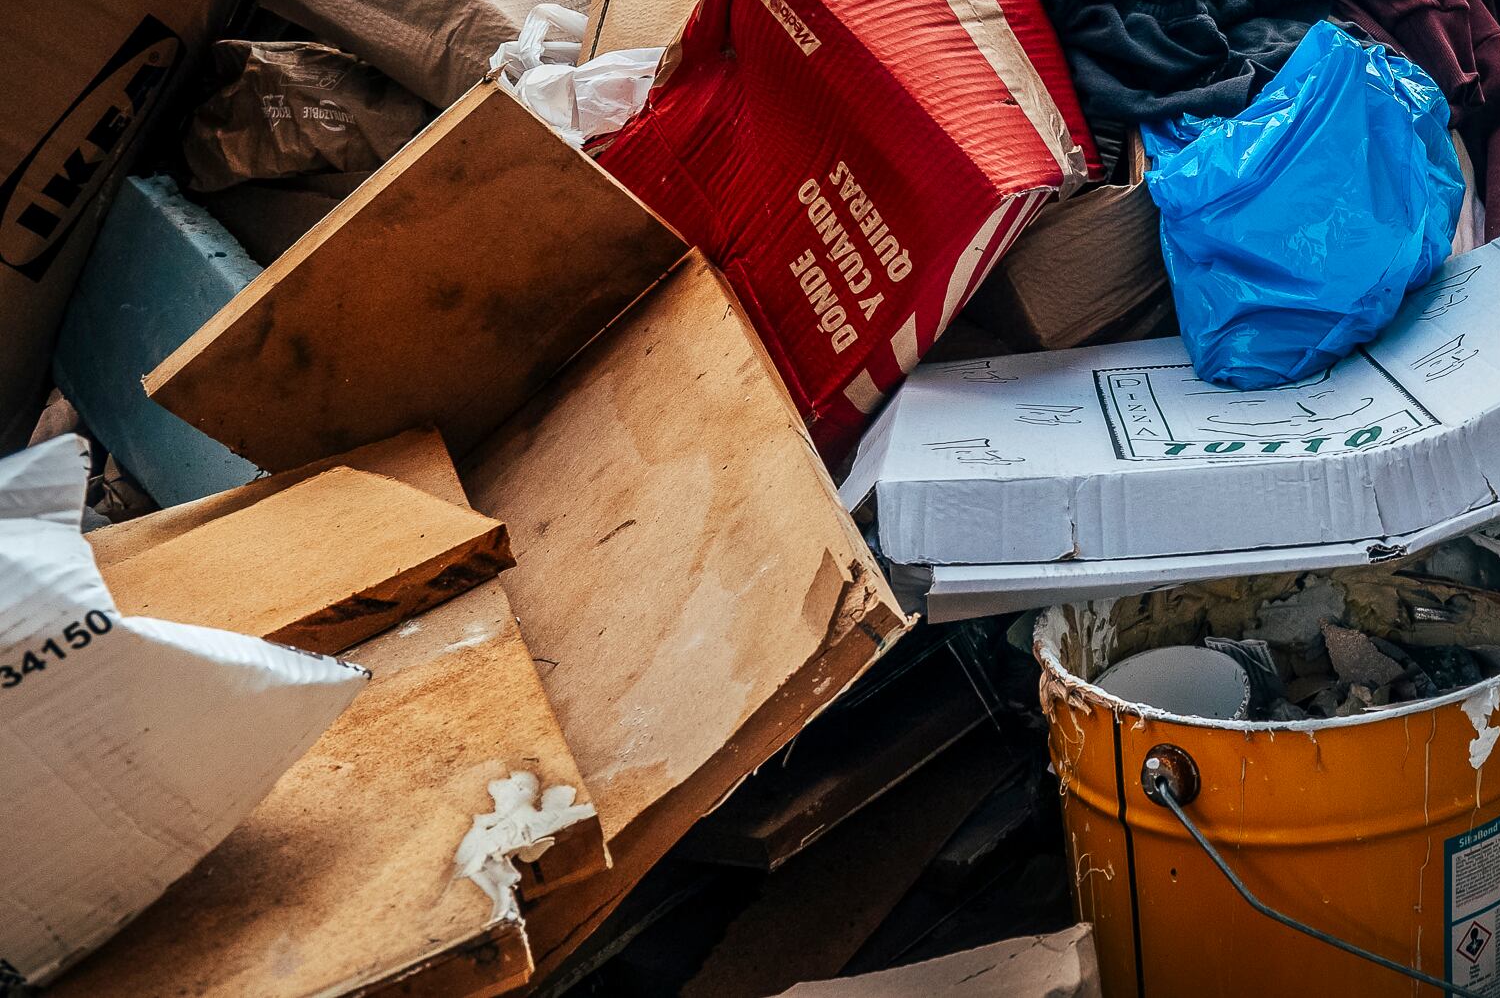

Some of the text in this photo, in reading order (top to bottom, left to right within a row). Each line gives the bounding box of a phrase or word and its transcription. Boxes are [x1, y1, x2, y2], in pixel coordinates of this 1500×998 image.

[779, 5, 816, 45] Media
[15, 63, 169, 240] IKEA
[798, 178, 885, 322] Y CUÁNDO
[829, 160, 913, 283] QUIERAS
[789, 248, 858, 355] DÓNDE
[1163, 425, 1382, 456] TUTTO
[0, 609, 113, 689] 34150
